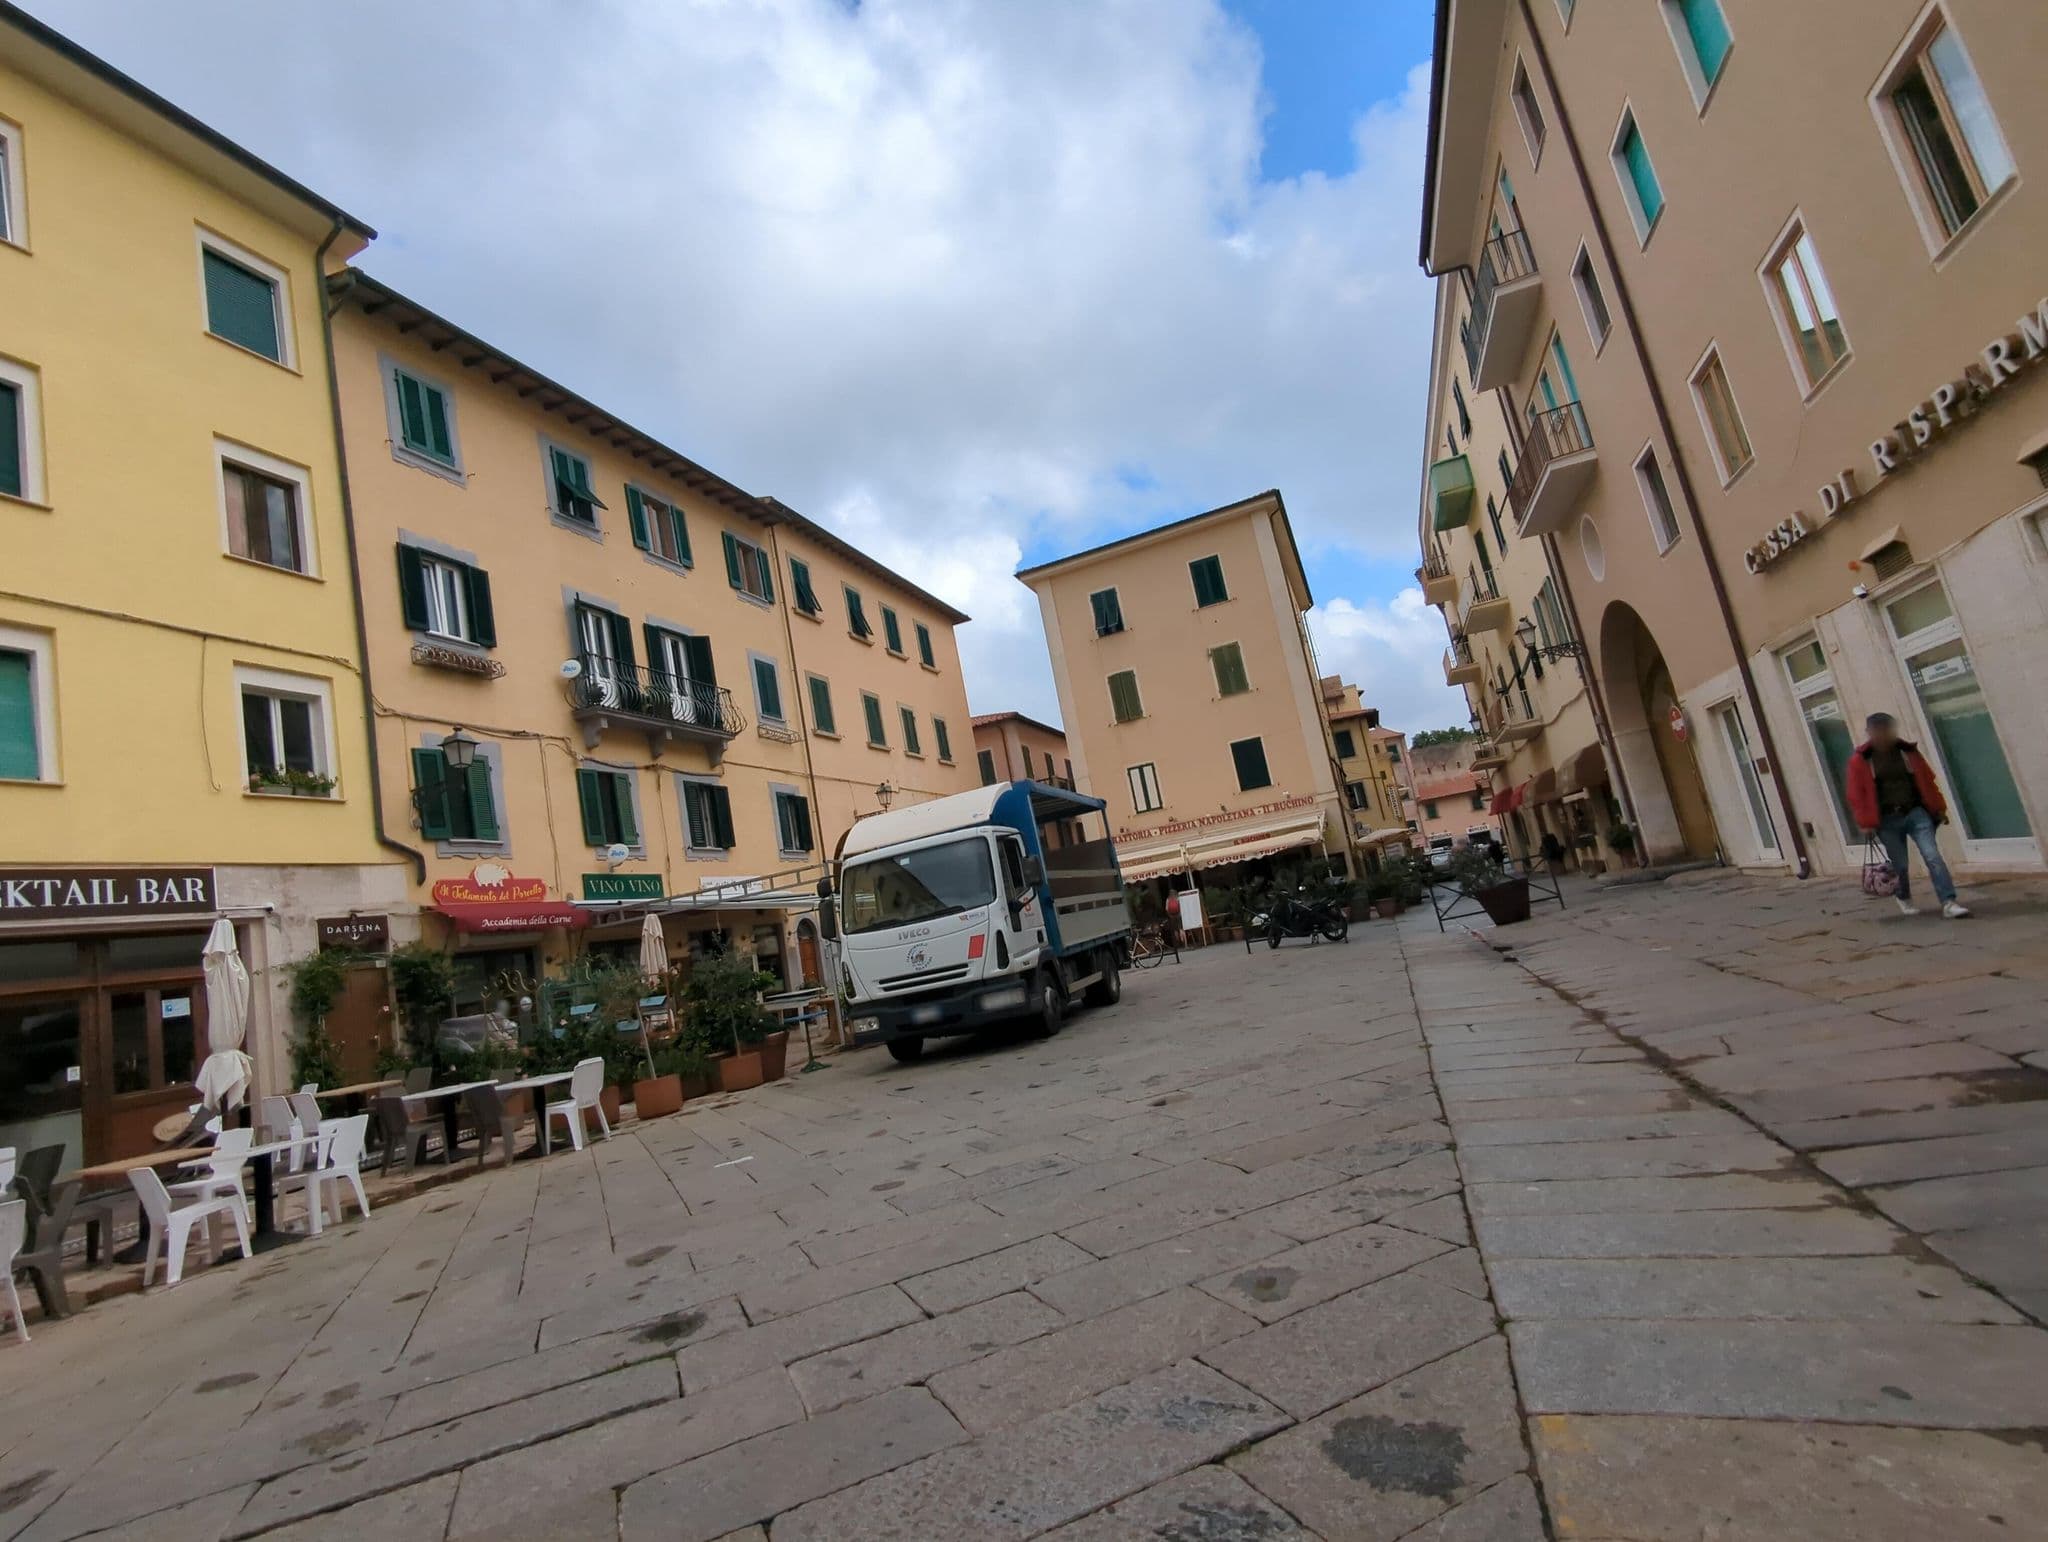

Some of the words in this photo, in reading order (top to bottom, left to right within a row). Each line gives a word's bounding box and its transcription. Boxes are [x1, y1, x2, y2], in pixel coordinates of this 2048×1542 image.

[1818, 469, 1853, 517] DI
[1158, 820, 1197, 836] PIZZERIA
[1199, 809, 1256, 827] NAPOLETANA
[1273, 796, 1314, 812] BUCHINO
[0, 878, 128, 908] KTAIL
[136, 877, 207, 904] BAR
[452, 885, 497, 902] Testamento
[513, 884, 542, 901] Porcello
[590, 880, 625, 893] VINO
[629, 880, 660, 893] VINO
[482, 917, 528, 927] Accademia
[529, 915, 547, 925] della
[548, 915, 572, 924] Carne
[326, 924, 381, 934] DARSENA
[898, 928, 931, 940] IVECO
